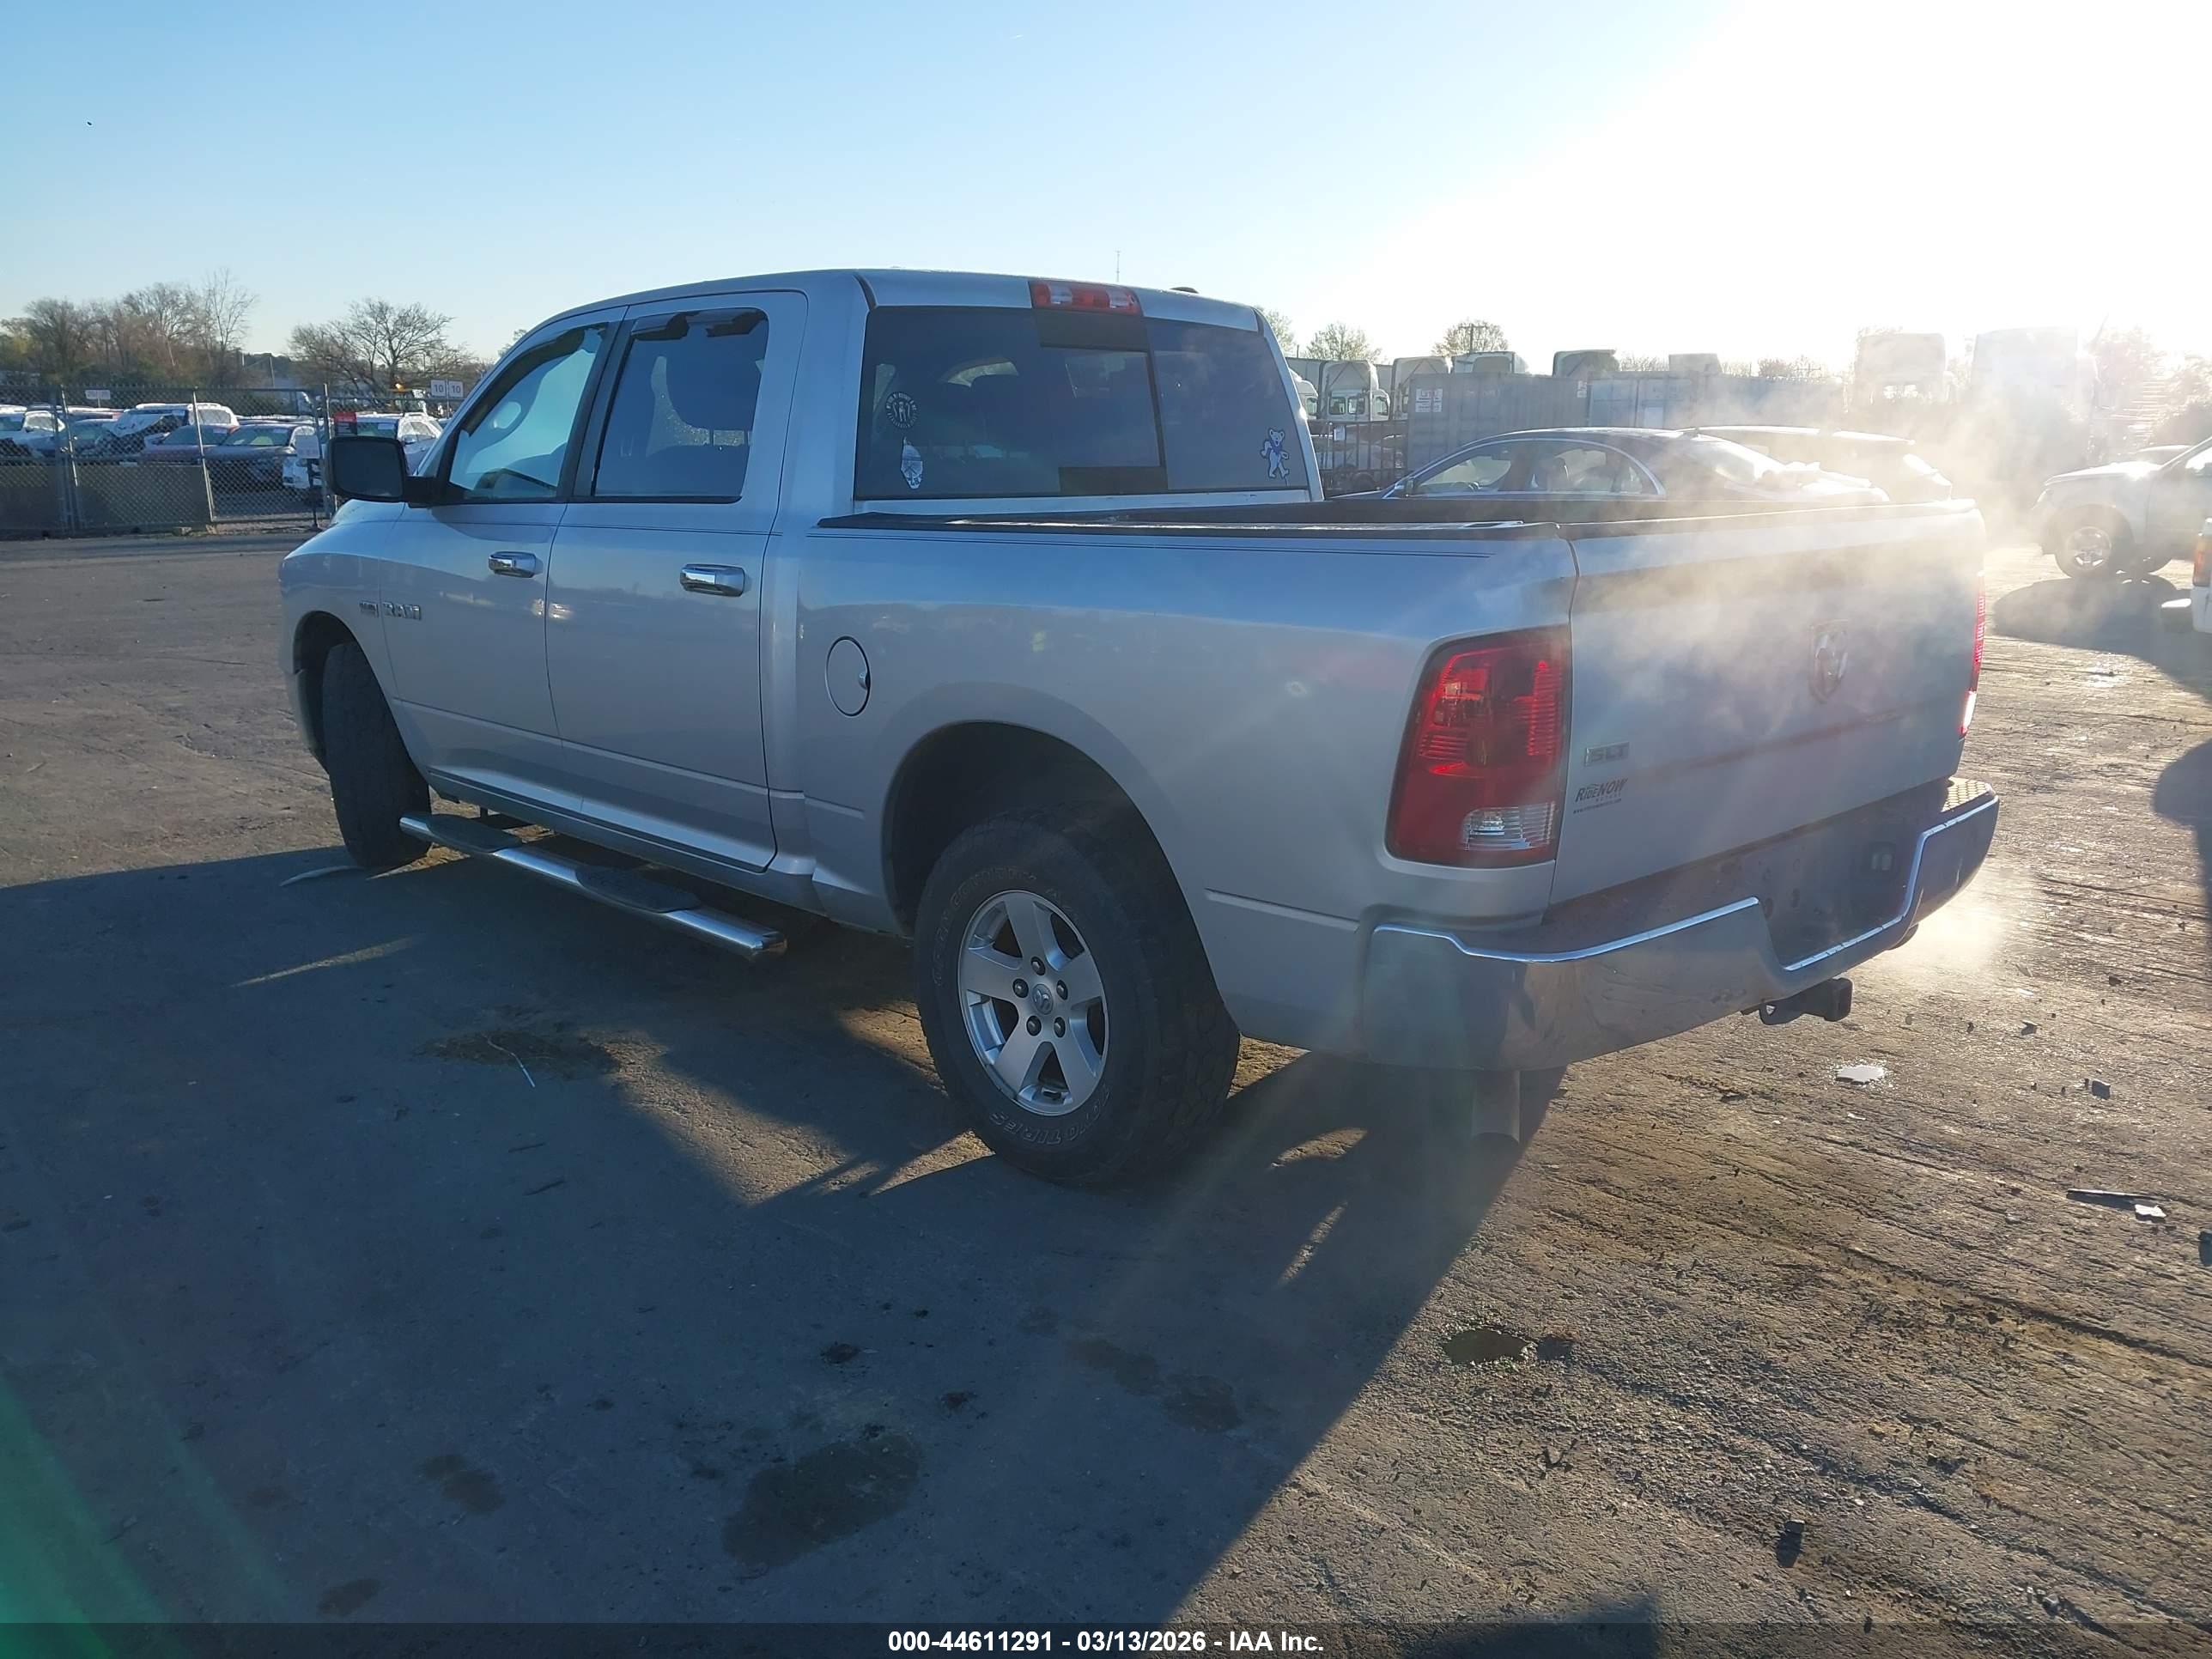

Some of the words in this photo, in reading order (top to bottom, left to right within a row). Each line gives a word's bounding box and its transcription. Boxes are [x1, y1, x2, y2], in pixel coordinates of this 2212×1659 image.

[434, 384, 444, 393] 10
[452, 385, 461, 394] 10
[383, 600, 422, 621] RAM
[1590, 744, 1628, 763] SLT
[988, 1112, 1062, 1146] TIRES
